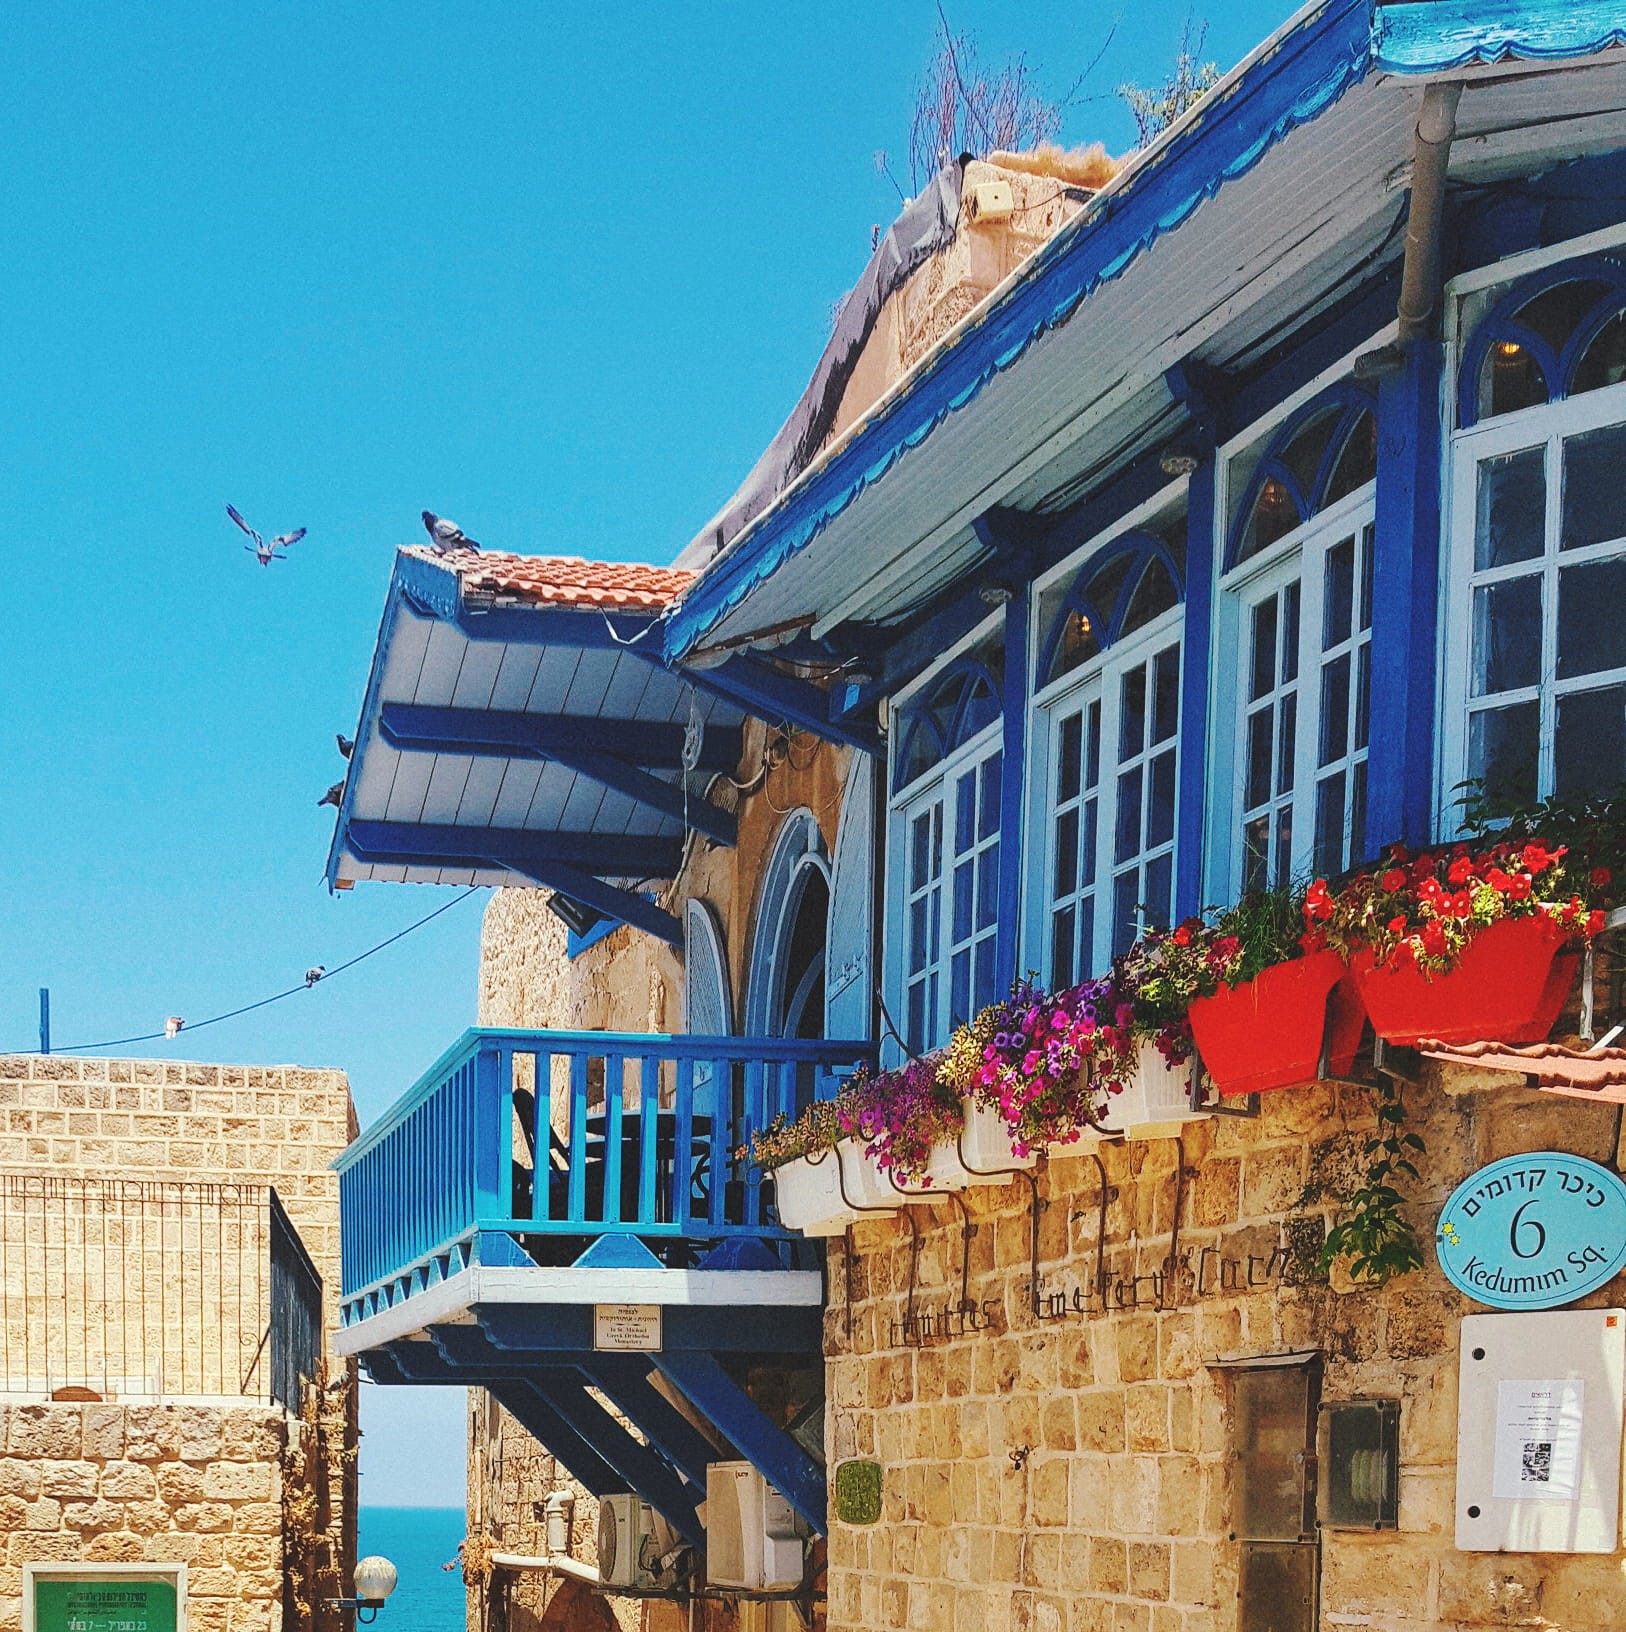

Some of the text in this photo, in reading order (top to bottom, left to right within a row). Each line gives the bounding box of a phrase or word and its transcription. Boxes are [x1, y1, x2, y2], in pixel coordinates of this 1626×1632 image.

[1461, 1169, 1606, 1218] כיכר קדומים
[1509, 1199, 1546, 1259] 6
[1461, 1245, 1609, 1294] Kedumim Sq.
